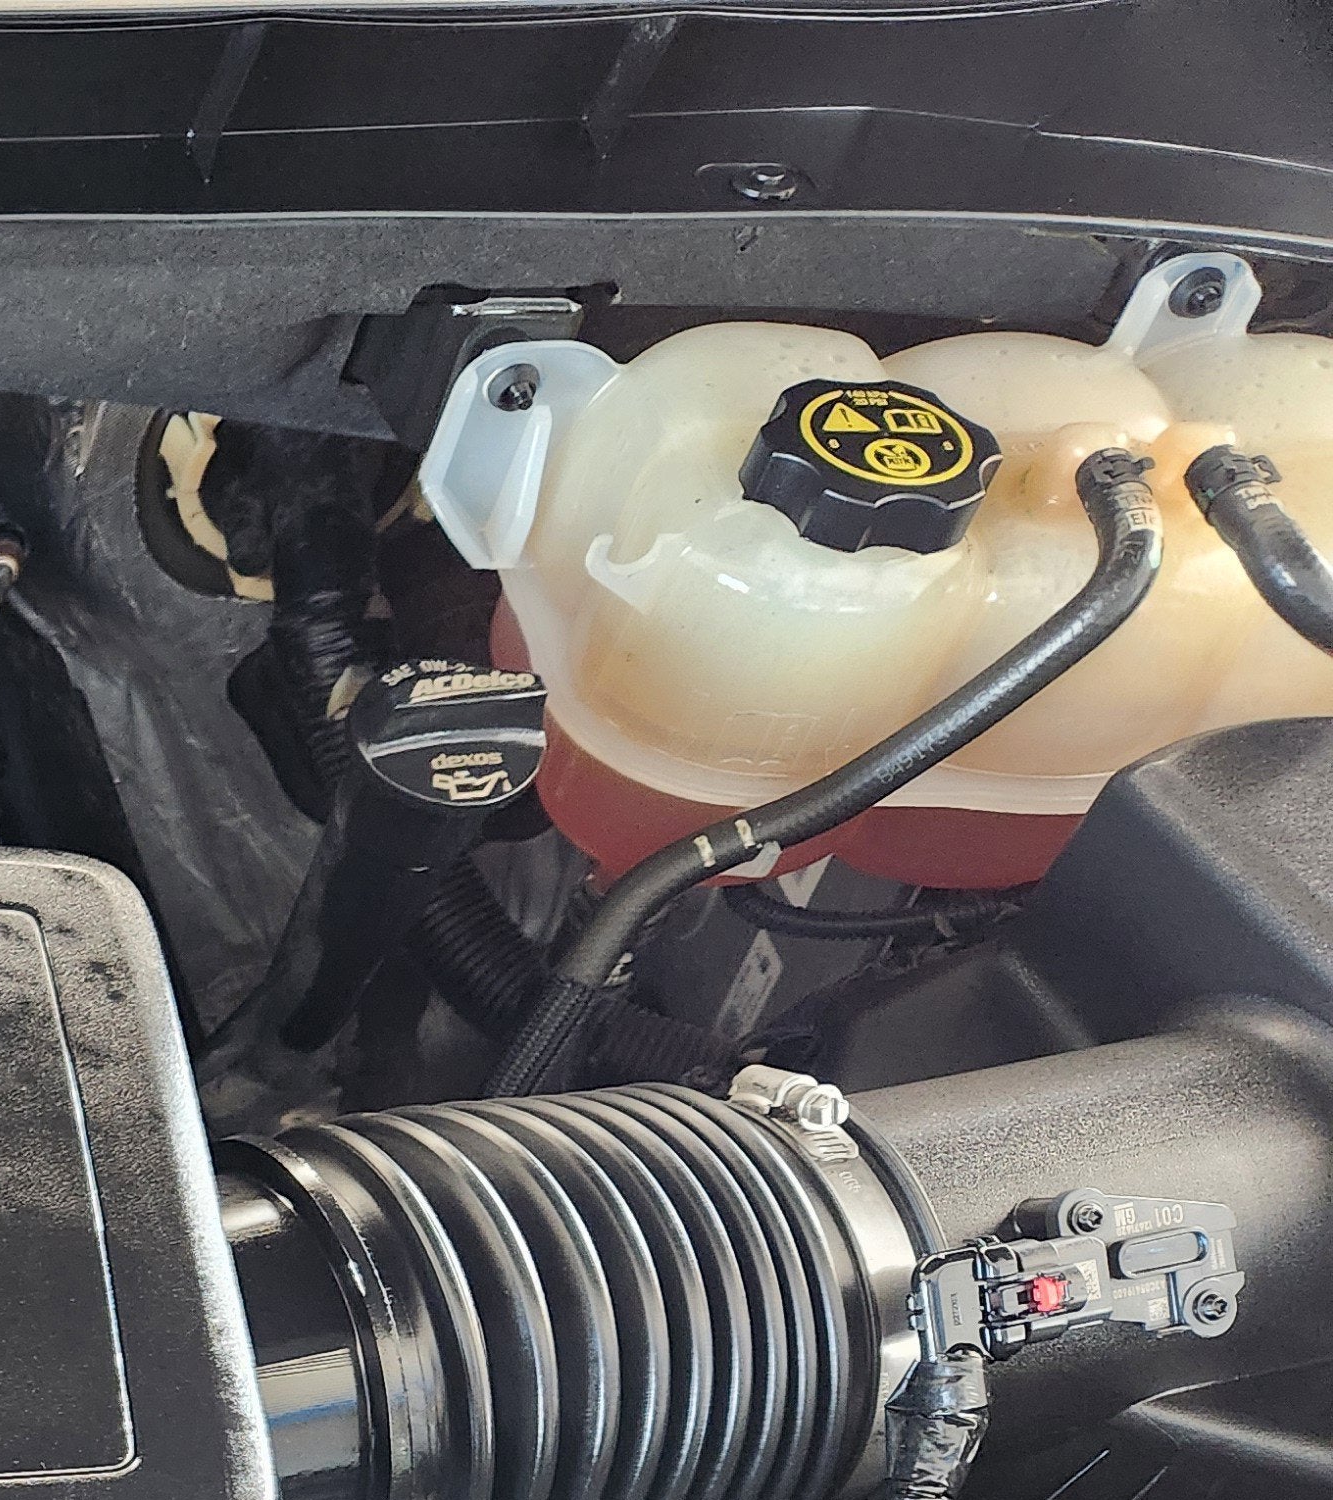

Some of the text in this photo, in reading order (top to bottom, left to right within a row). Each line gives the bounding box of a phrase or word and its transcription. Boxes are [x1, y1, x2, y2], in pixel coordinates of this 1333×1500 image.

[381, 663, 416, 686] SAE
[409, 670, 536, 699] ACDelco
[431, 753, 503, 770] dexos
[1115, 1204, 1136, 1226] GM
[1154, 1204, 1183, 1228] C01
